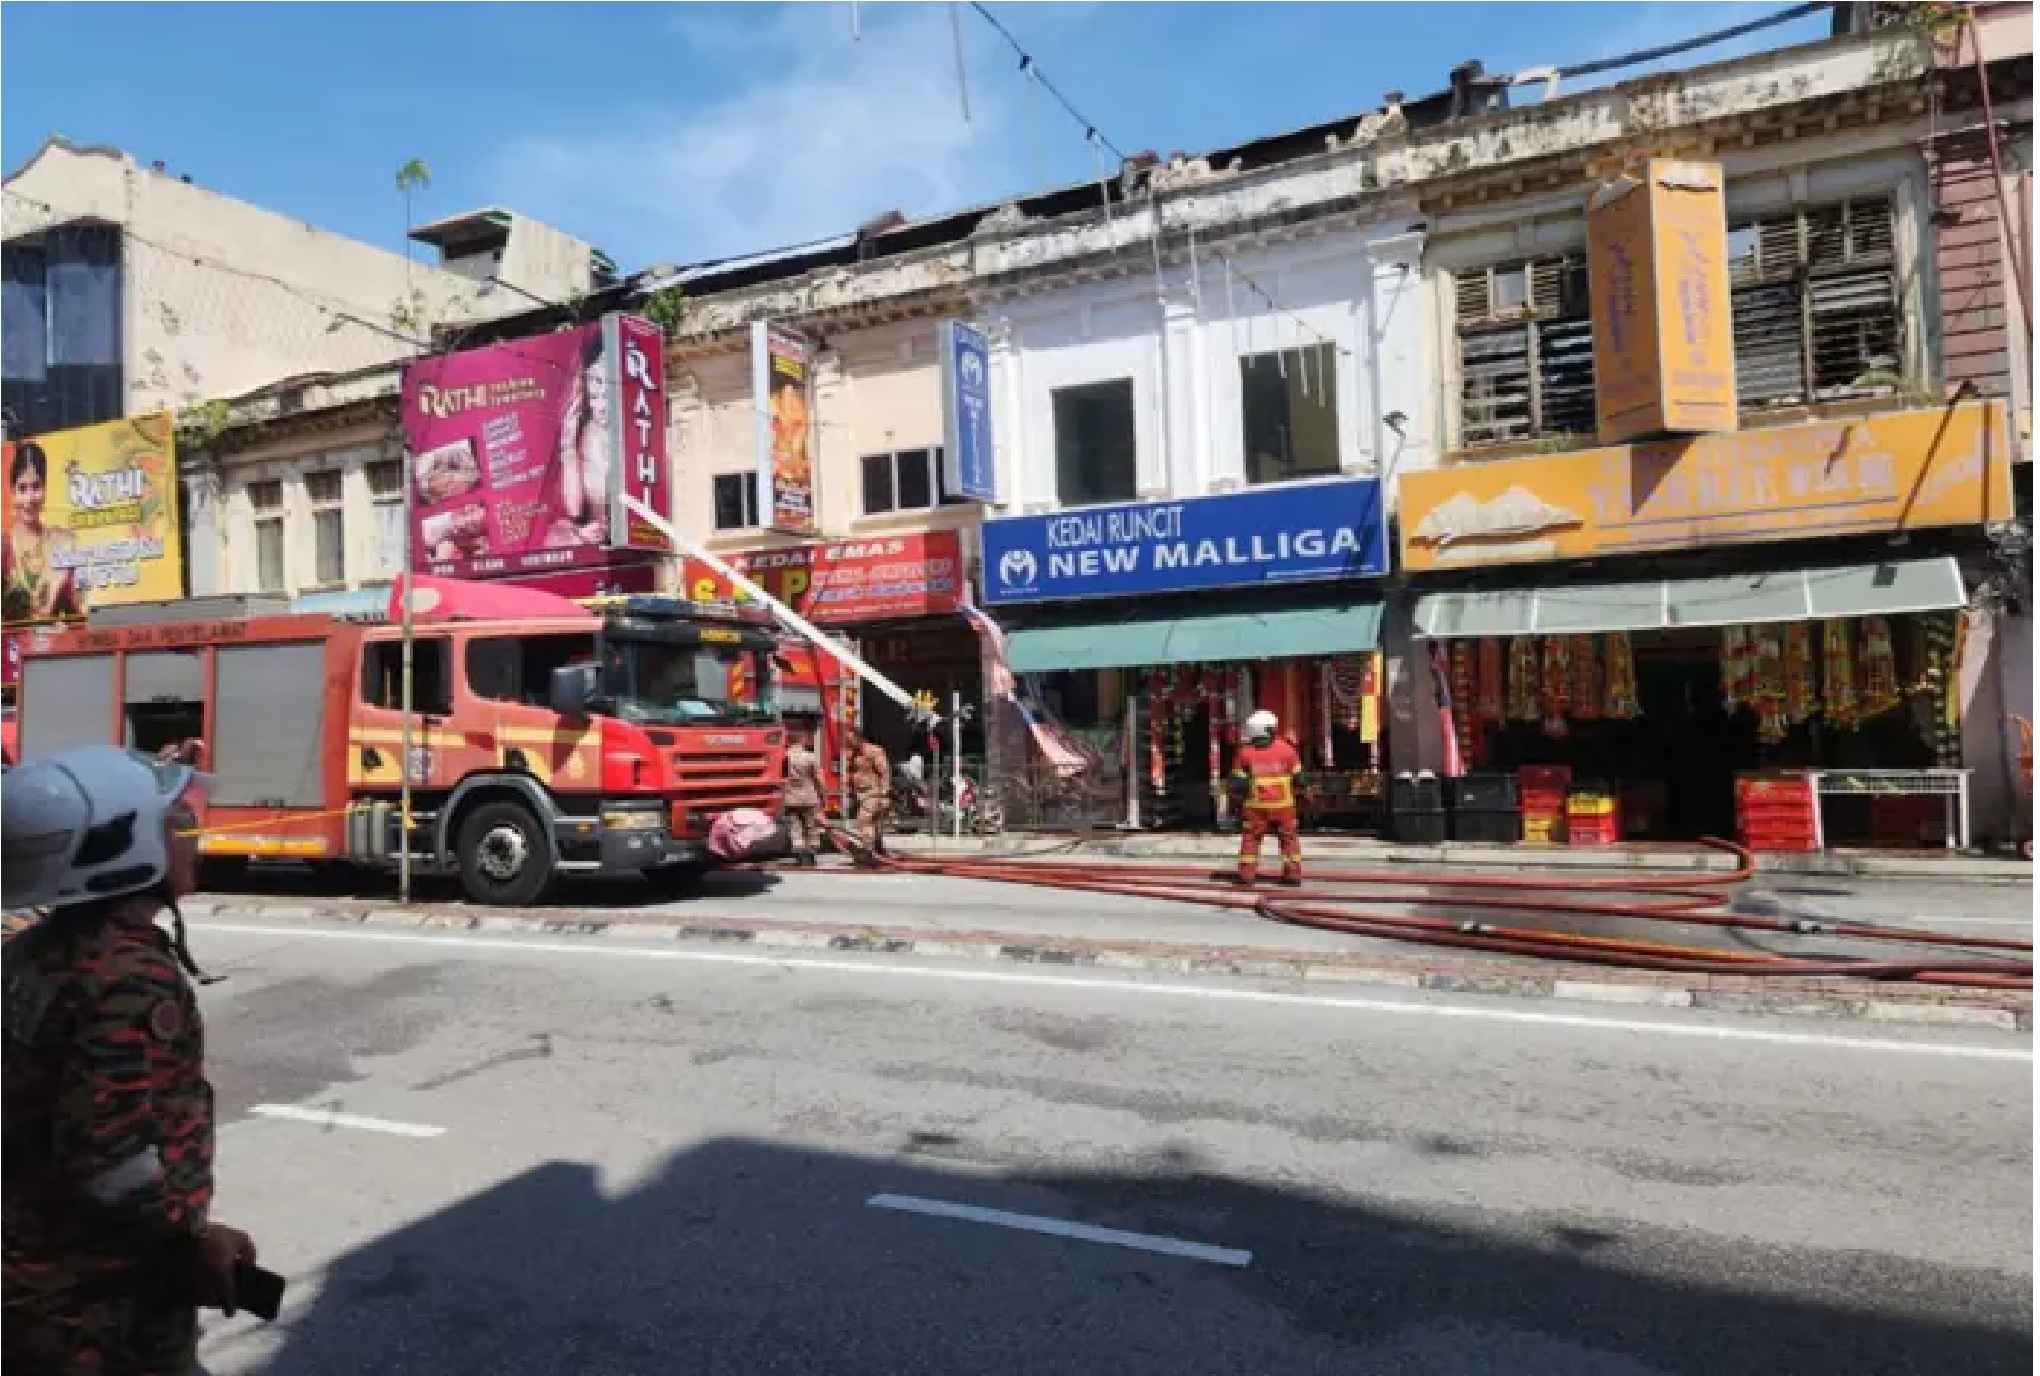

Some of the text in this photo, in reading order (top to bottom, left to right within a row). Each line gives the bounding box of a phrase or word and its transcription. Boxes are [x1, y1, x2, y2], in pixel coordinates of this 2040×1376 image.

[419, 383, 487, 418] RATHI
[626, 347, 658, 513] RATHI
[69, 469, 144, 508] RATHI
[1048, 508, 1185, 547] KEDAI RUNCIT
[824, 539, 904, 560] EMAS
[1048, 526, 1362, 579] NEW MALLIGA
